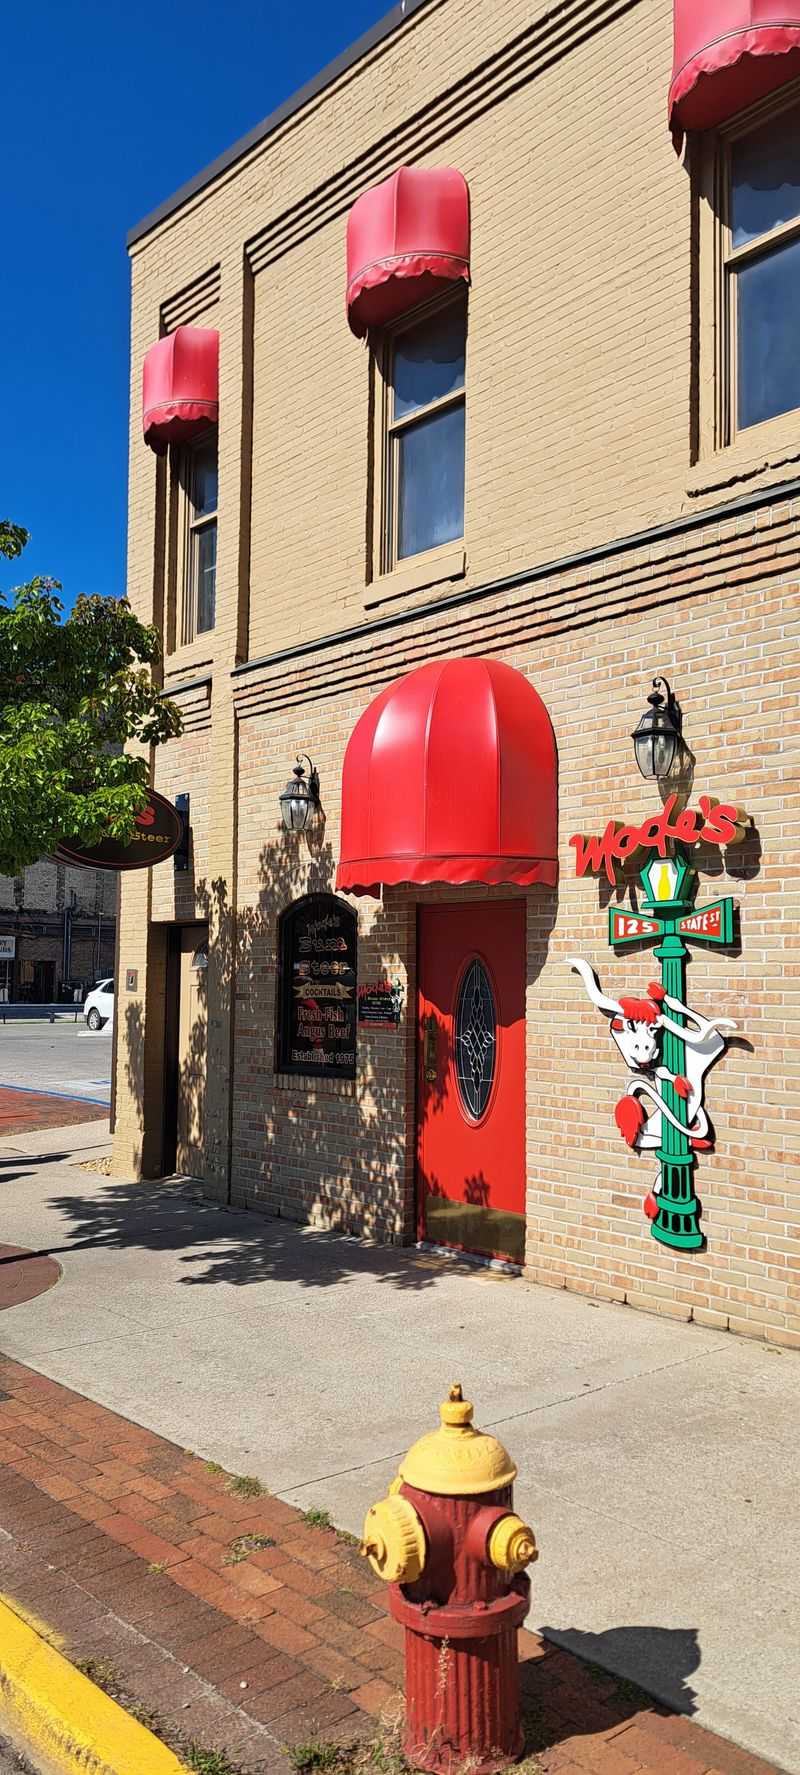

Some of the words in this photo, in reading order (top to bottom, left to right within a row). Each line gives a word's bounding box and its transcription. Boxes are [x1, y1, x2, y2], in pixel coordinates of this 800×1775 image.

[569, 793, 738, 886] Mode's
[618, 917, 655, 937] 125
[680, 914, 709, 931] STATE
[305, 987, 342, 997] COCKTAILS
[297, 1022, 326, 1042] Angus
[327, 1023, 352, 1039] Beef
[291, 1049, 334, 1064] Established
[335, 1052, 354, 1064] 1975
